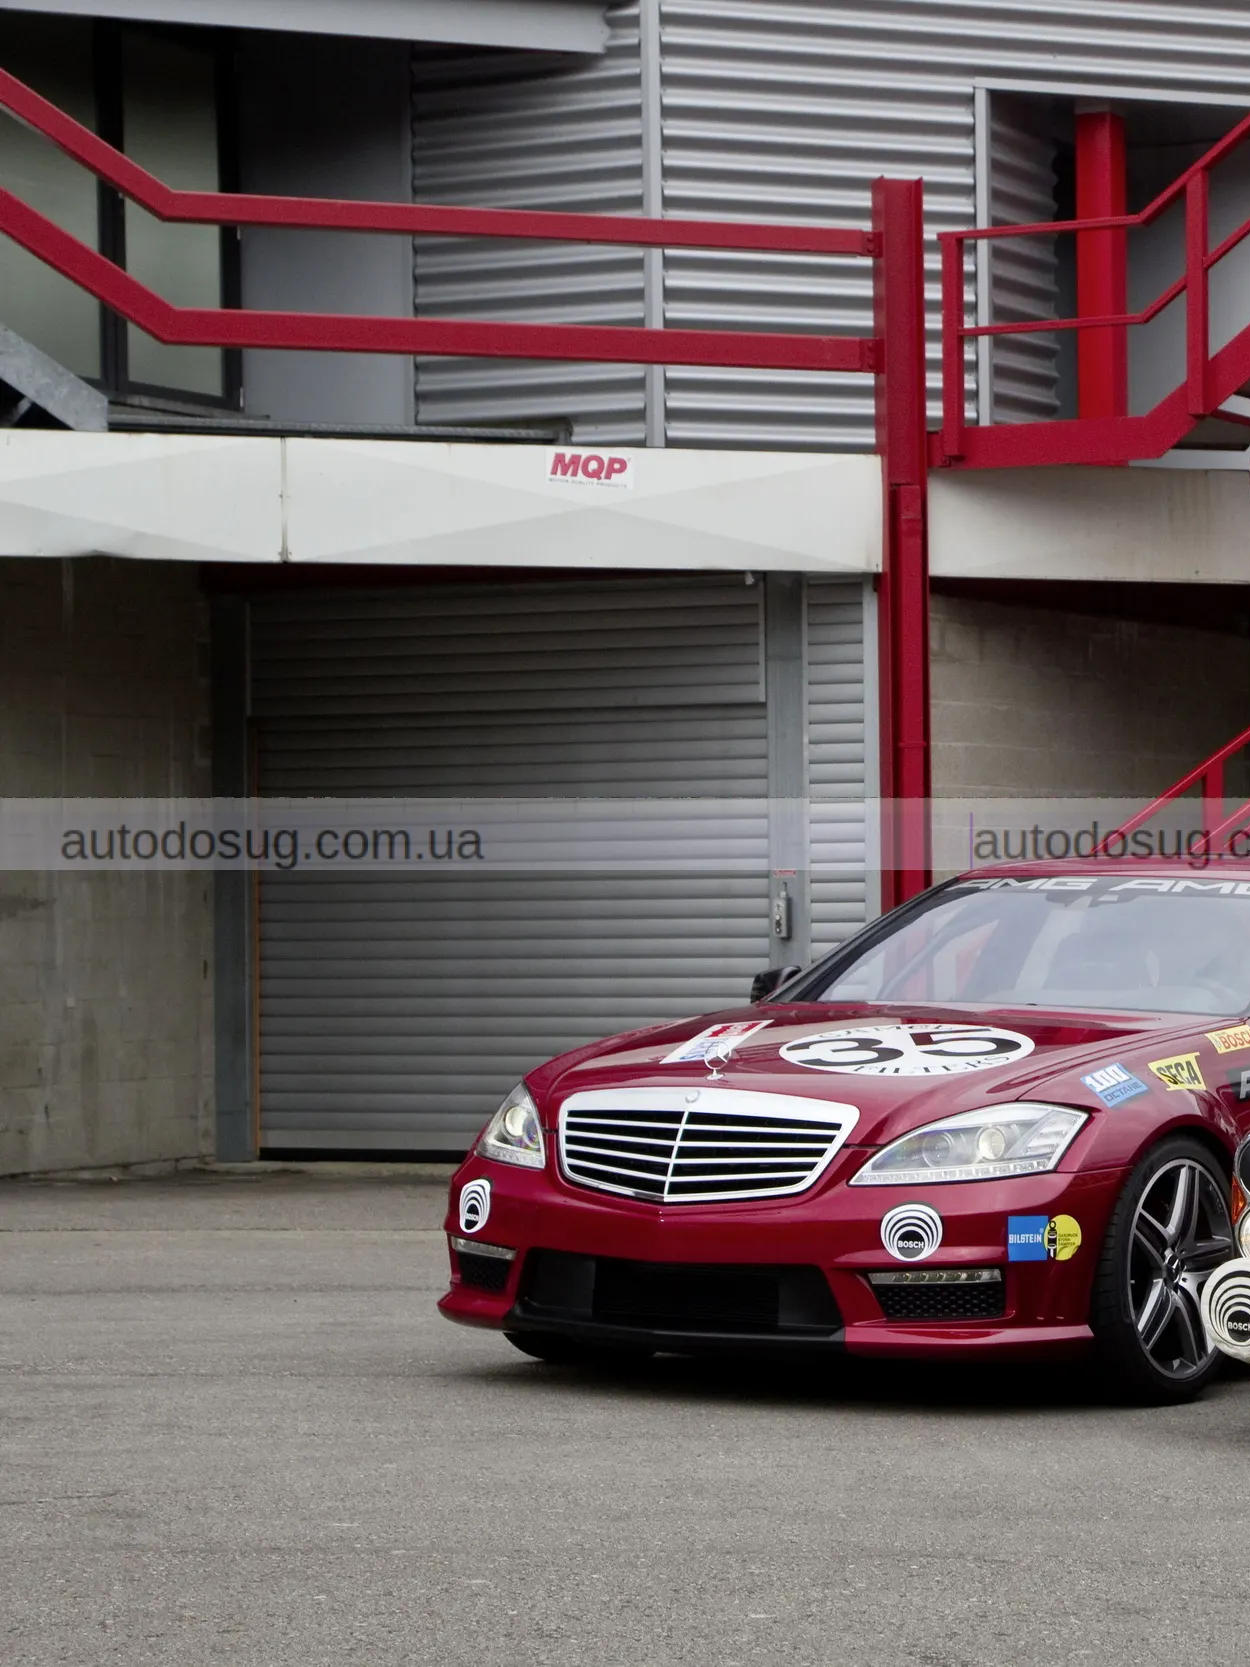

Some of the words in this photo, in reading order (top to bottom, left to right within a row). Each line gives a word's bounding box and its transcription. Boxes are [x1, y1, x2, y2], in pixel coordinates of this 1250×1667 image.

[551, 452, 628, 480] MQP
[944, 878, 1098, 891] AMG
[786, 1028, 1022, 1066] 35
[1085, 1064, 1132, 1092] 100
[1156, 1060, 1201, 1085] SECA
[1105, 1082, 1143, 1102] OCTANE
[897, 1240, 925, 1249] BOSCH
[1008, 1233, 1042, 1244] BILSTEIN
